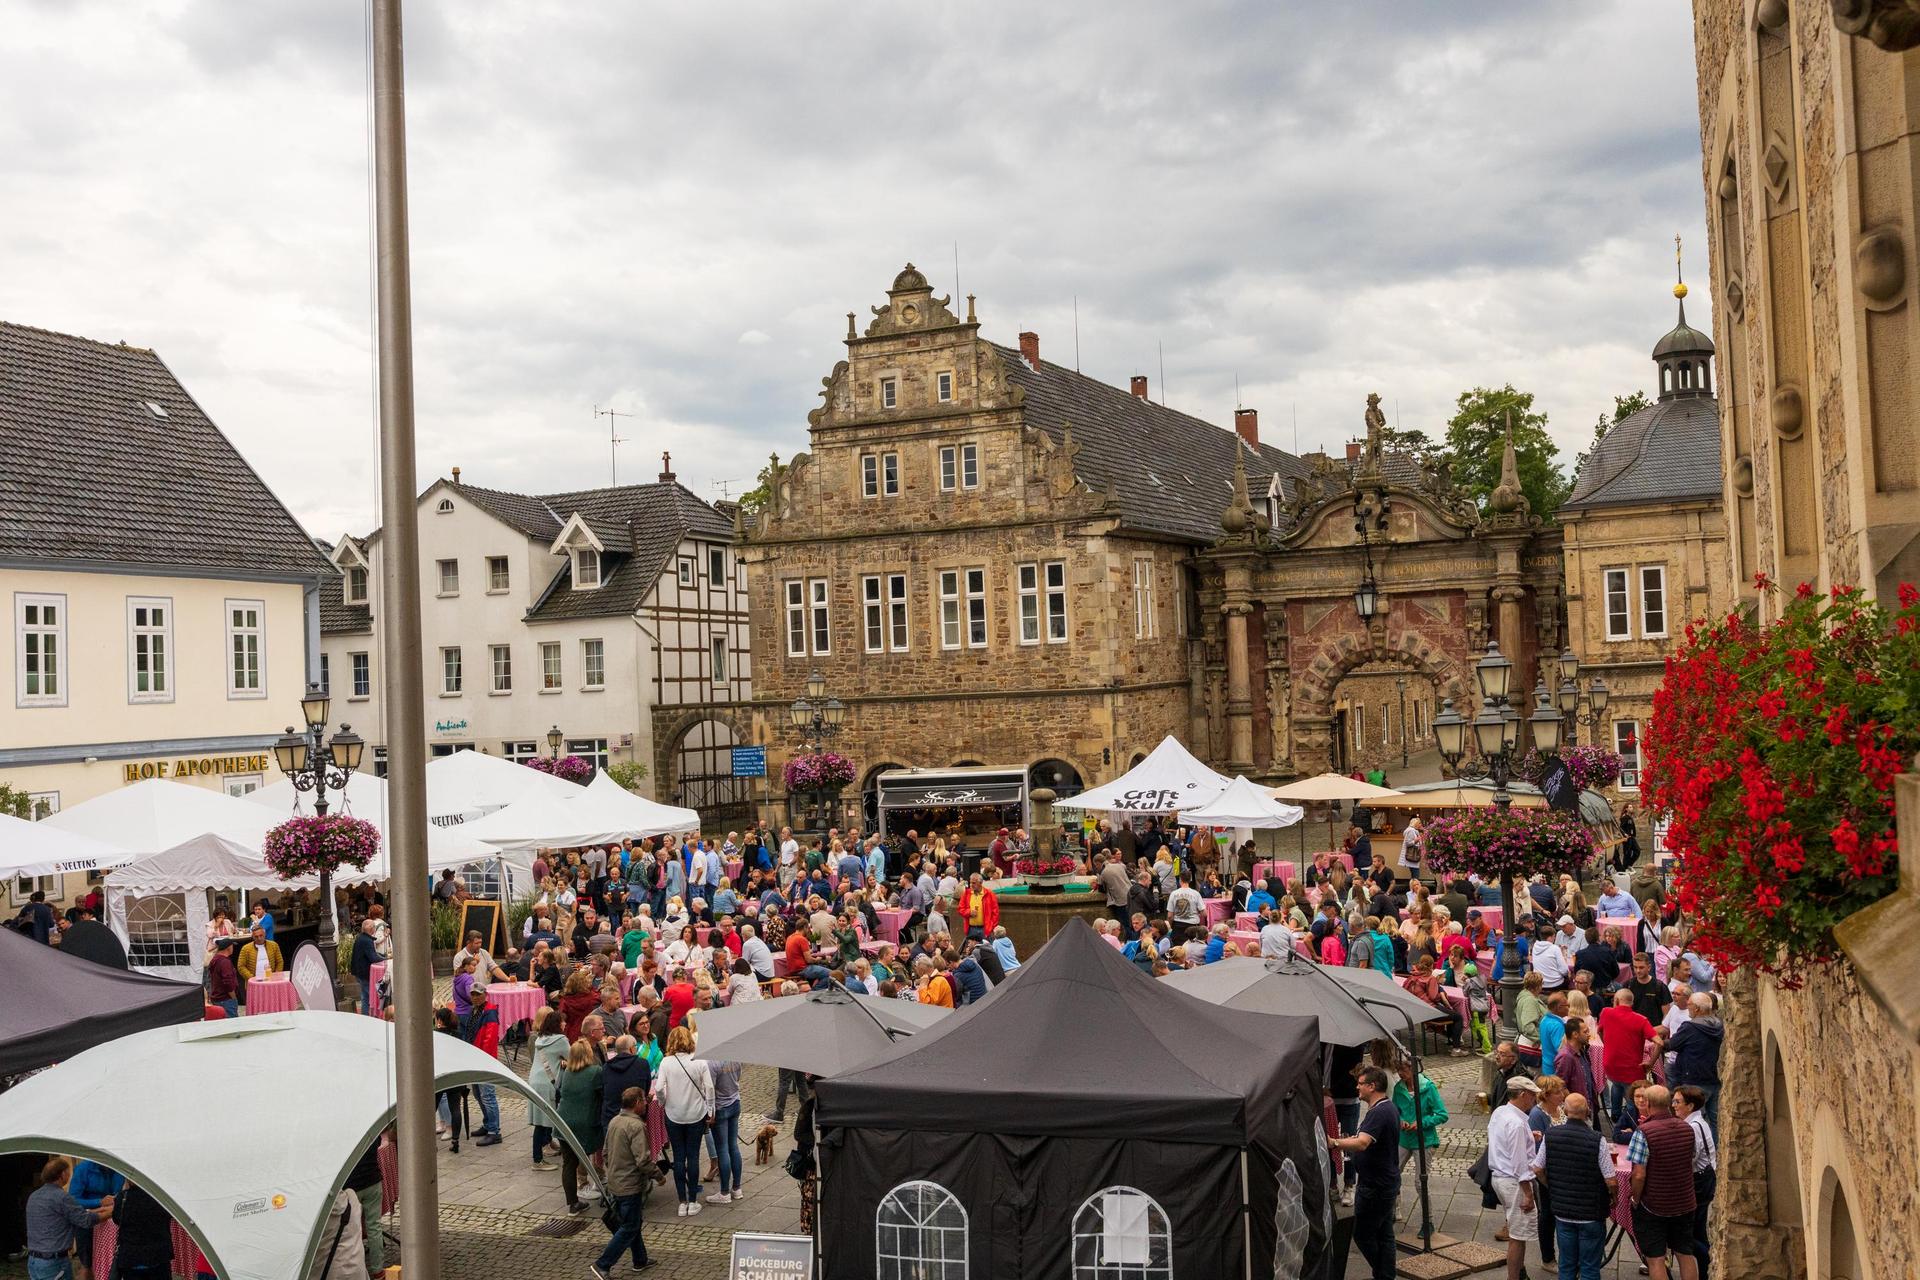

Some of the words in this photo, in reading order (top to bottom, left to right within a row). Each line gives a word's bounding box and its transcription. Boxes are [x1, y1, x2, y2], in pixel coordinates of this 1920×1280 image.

[125, 762, 168, 781] HOF
[174, 755, 269, 776] APOTHEKE
[1124, 790, 1179, 801] Craft
[1124, 799, 1176, 810] Kult
[431, 813, 464, 827] VELTINS
[62, 859, 97, 871] VELTINS
[739, 1256, 803, 1270] BÜCKEBURG
[738, 1269, 805, 1280] SCHÄUMT
